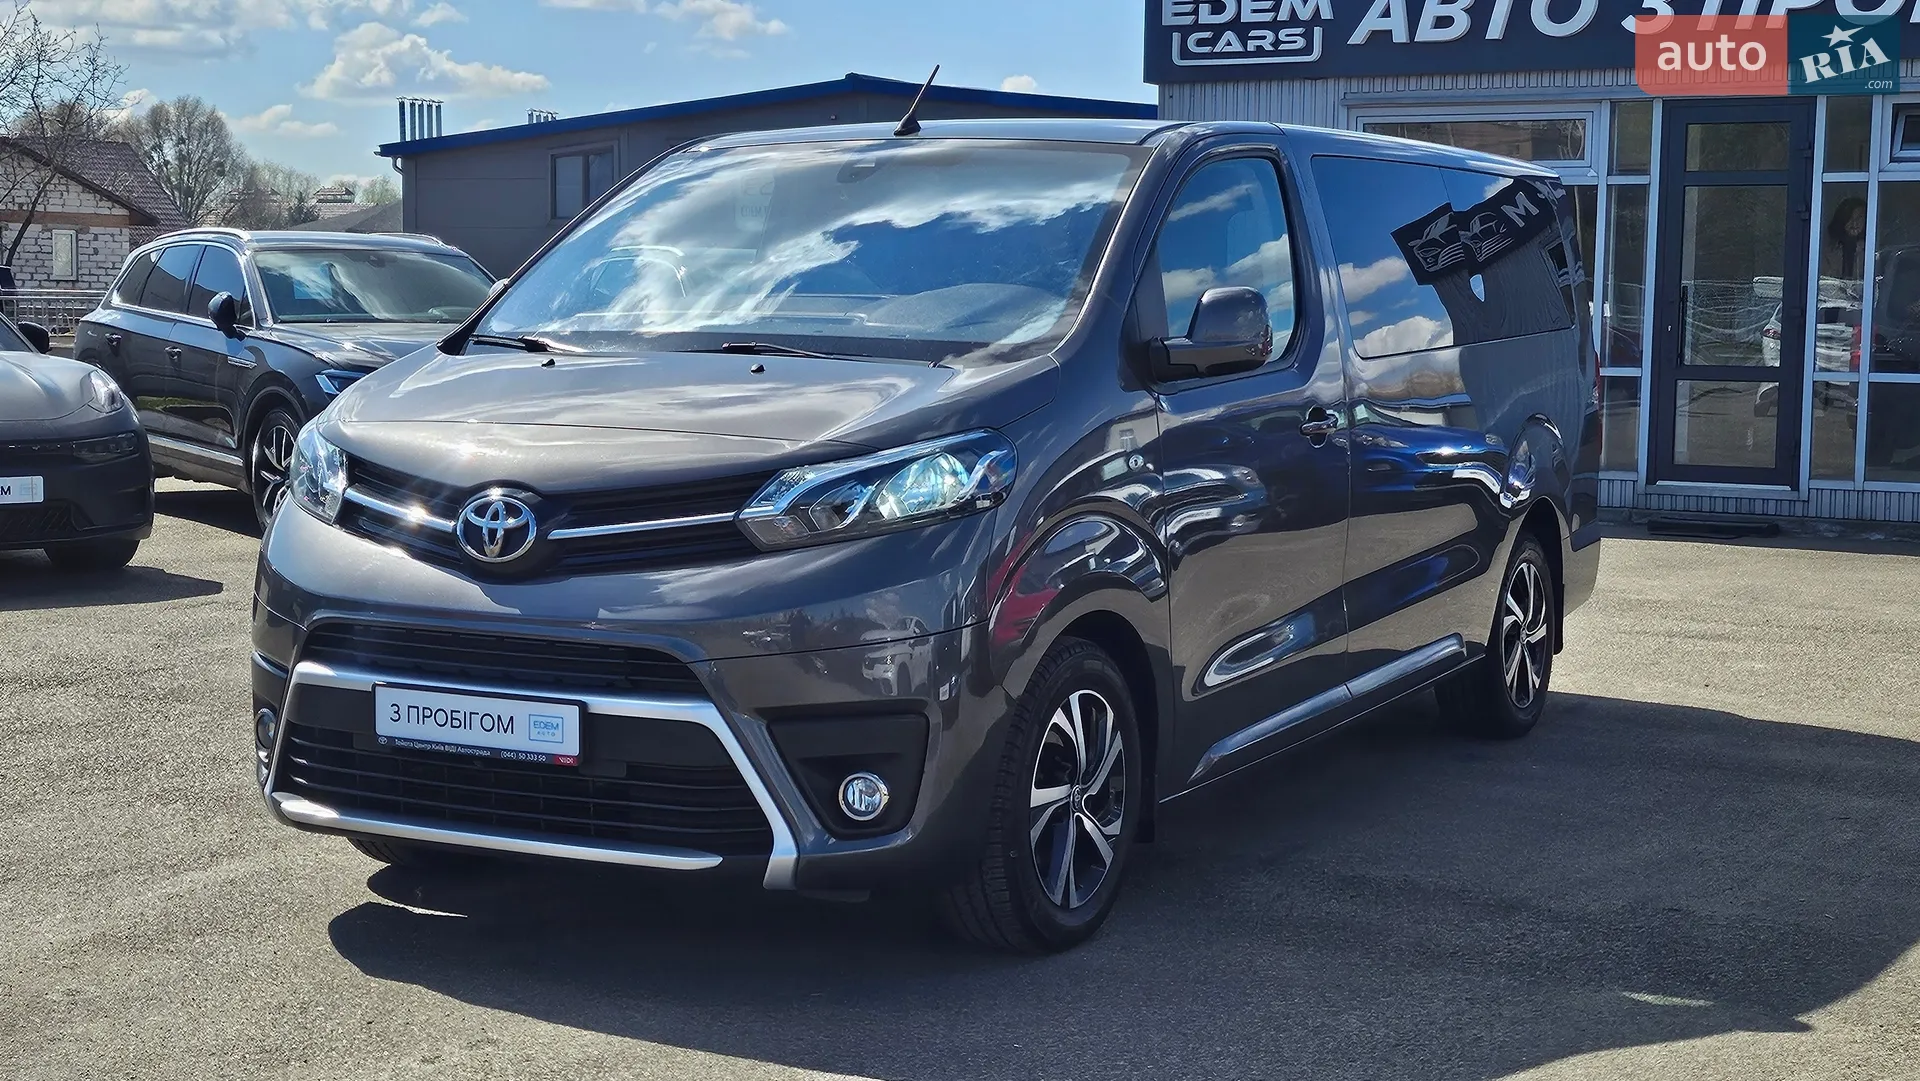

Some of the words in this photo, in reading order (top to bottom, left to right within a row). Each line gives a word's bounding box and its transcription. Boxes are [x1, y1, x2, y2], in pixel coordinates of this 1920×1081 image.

[1162, 0, 1334, 25] EDEM
[1187, 27, 1307, 53] CARS
[389, 703, 401, 722] З
[407, 704, 514, 735] ПРОБІГОМ
[533, 720, 560, 731] EDEM
